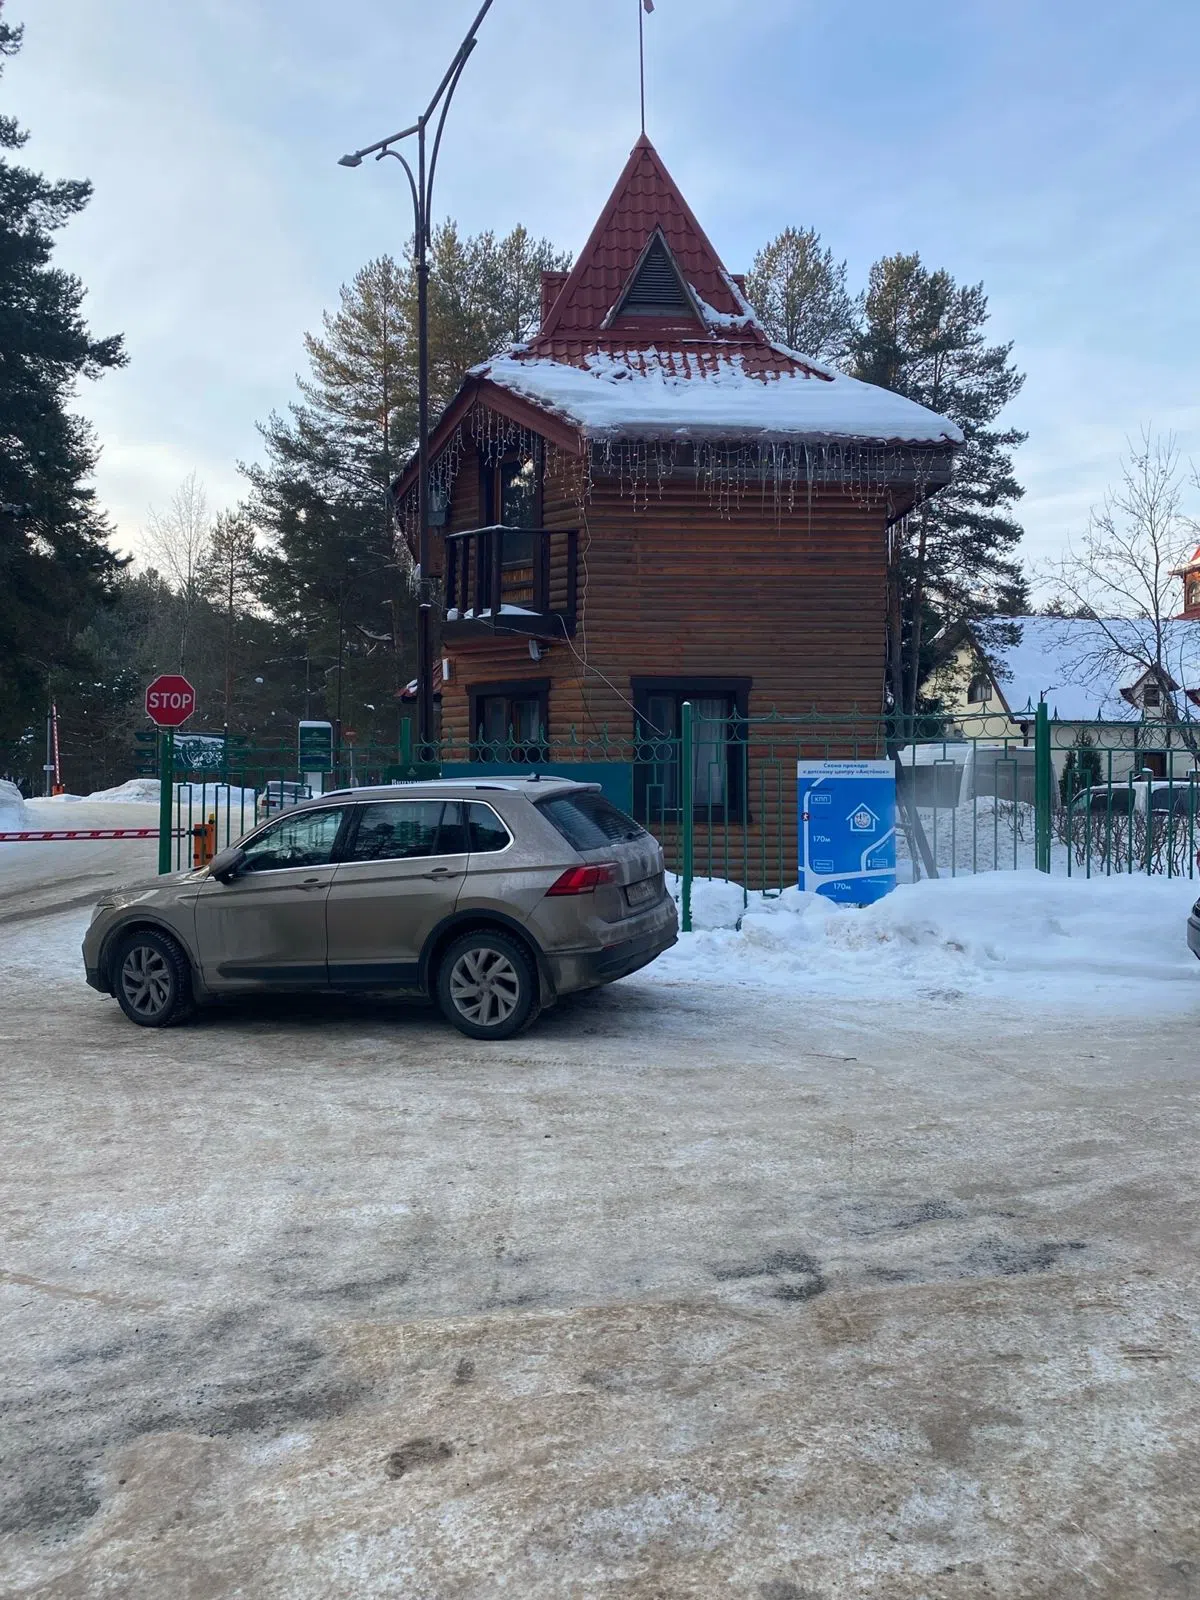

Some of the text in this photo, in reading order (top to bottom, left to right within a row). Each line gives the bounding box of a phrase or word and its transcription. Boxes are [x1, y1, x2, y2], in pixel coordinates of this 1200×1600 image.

[148, 692, 192, 710] STOP
[812, 835, 831, 843] 170м
[833, 882, 852, 890] 170м
